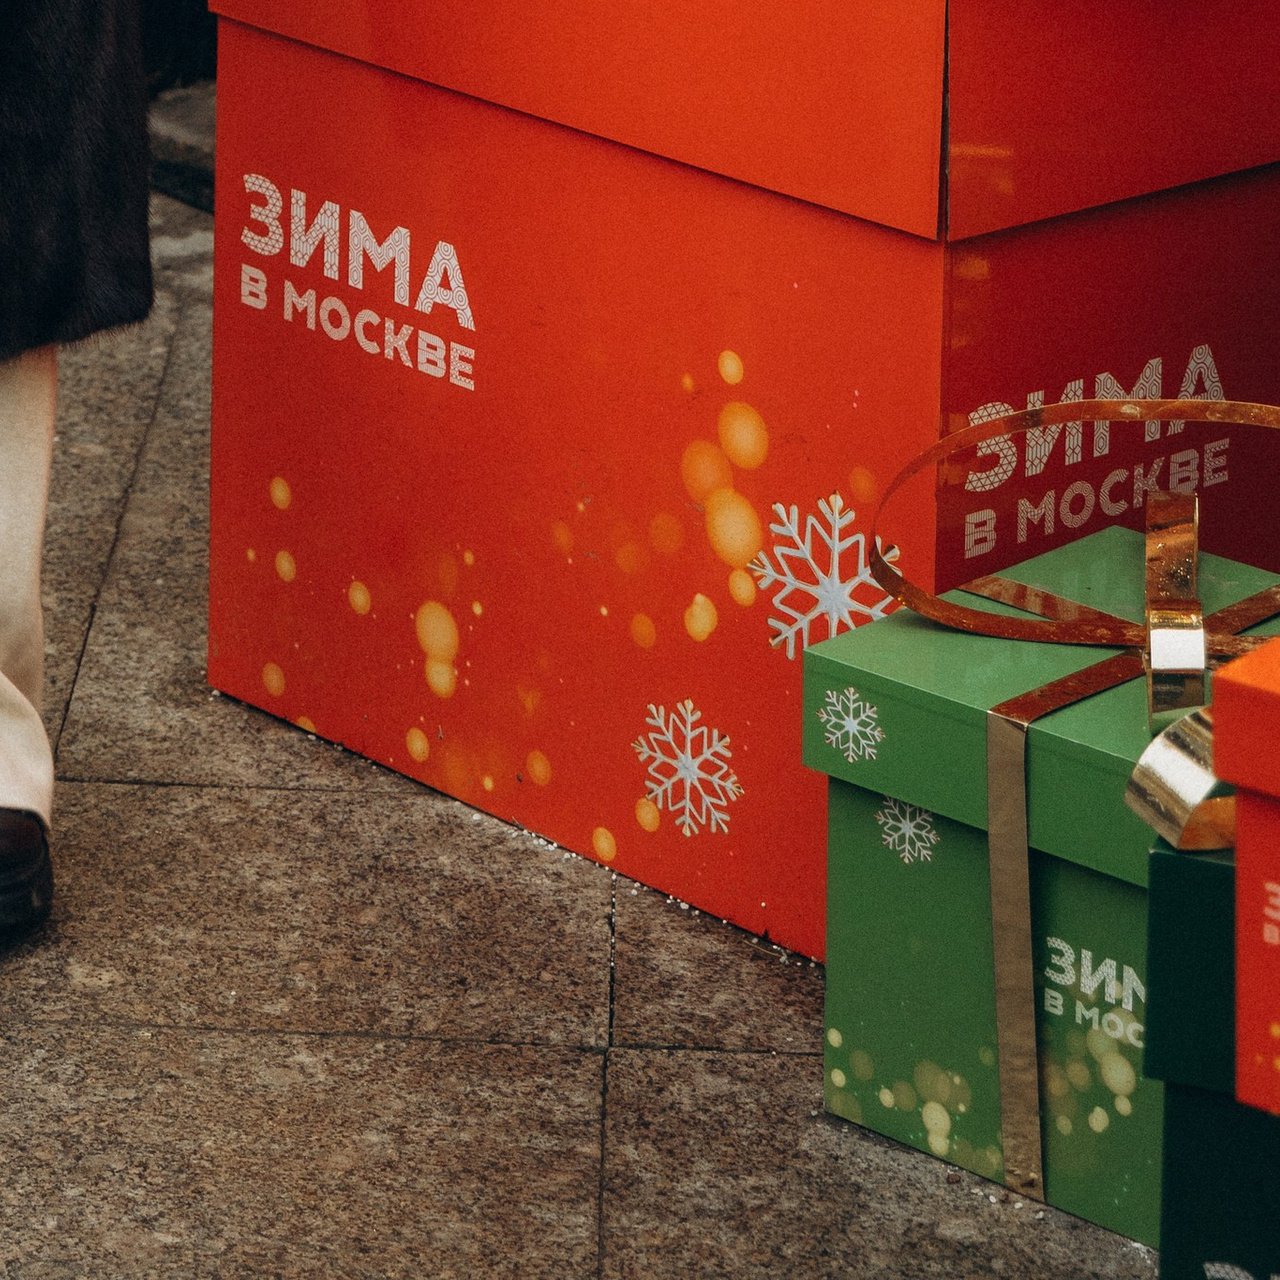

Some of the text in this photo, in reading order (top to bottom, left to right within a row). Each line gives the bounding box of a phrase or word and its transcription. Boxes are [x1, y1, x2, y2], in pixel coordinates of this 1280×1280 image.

[241, 173, 477, 332] ЗИМА
[241, 263, 476, 392] В МОСКВЕ
[964, 343, 1226, 493] ЗИМА
[964, 438, 1230, 560] В МОСКВЕ
[1044, 937, 1146, 1012] ЗИМ
[1044, 987, 1145, 1049] В МОС
